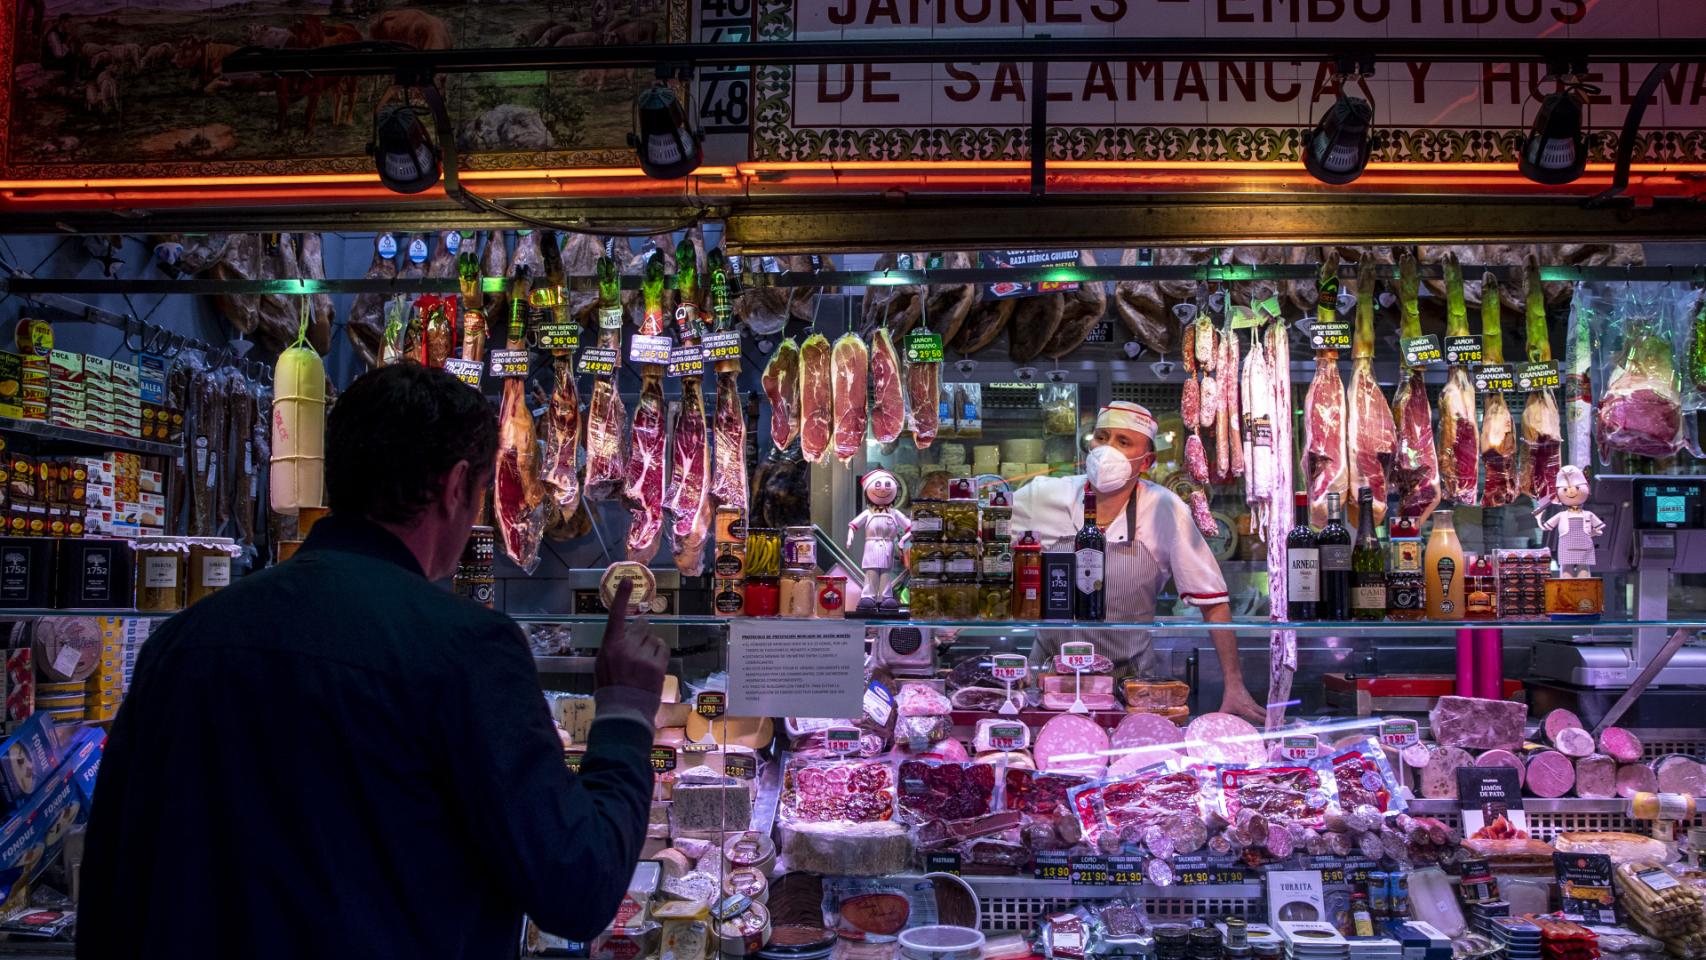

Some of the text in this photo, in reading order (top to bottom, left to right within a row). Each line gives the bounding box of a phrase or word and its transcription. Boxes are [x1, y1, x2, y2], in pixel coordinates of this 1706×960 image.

[817, 62, 900, 103] DE
[1407, 61, 1433, 104] Y
[700, 80, 748, 125] 48
[51, 351, 70, 361] CUCA
[86, 356, 103, 366] CUCA
[114, 362, 131, 371] CUCA
[1519, 369, 1557, 379] GRANADINO
[140, 381, 162, 393] BALEA
[5, 566, 27, 574] 1752
[87, 567, 108, 575] 1752
[43, 784, 71, 819] FONDUE
[2, 826, 36, 861] FONDUE
[1081, 871, 1108, 881] 21'90
[1115, 872, 1142, 882] 21'90
